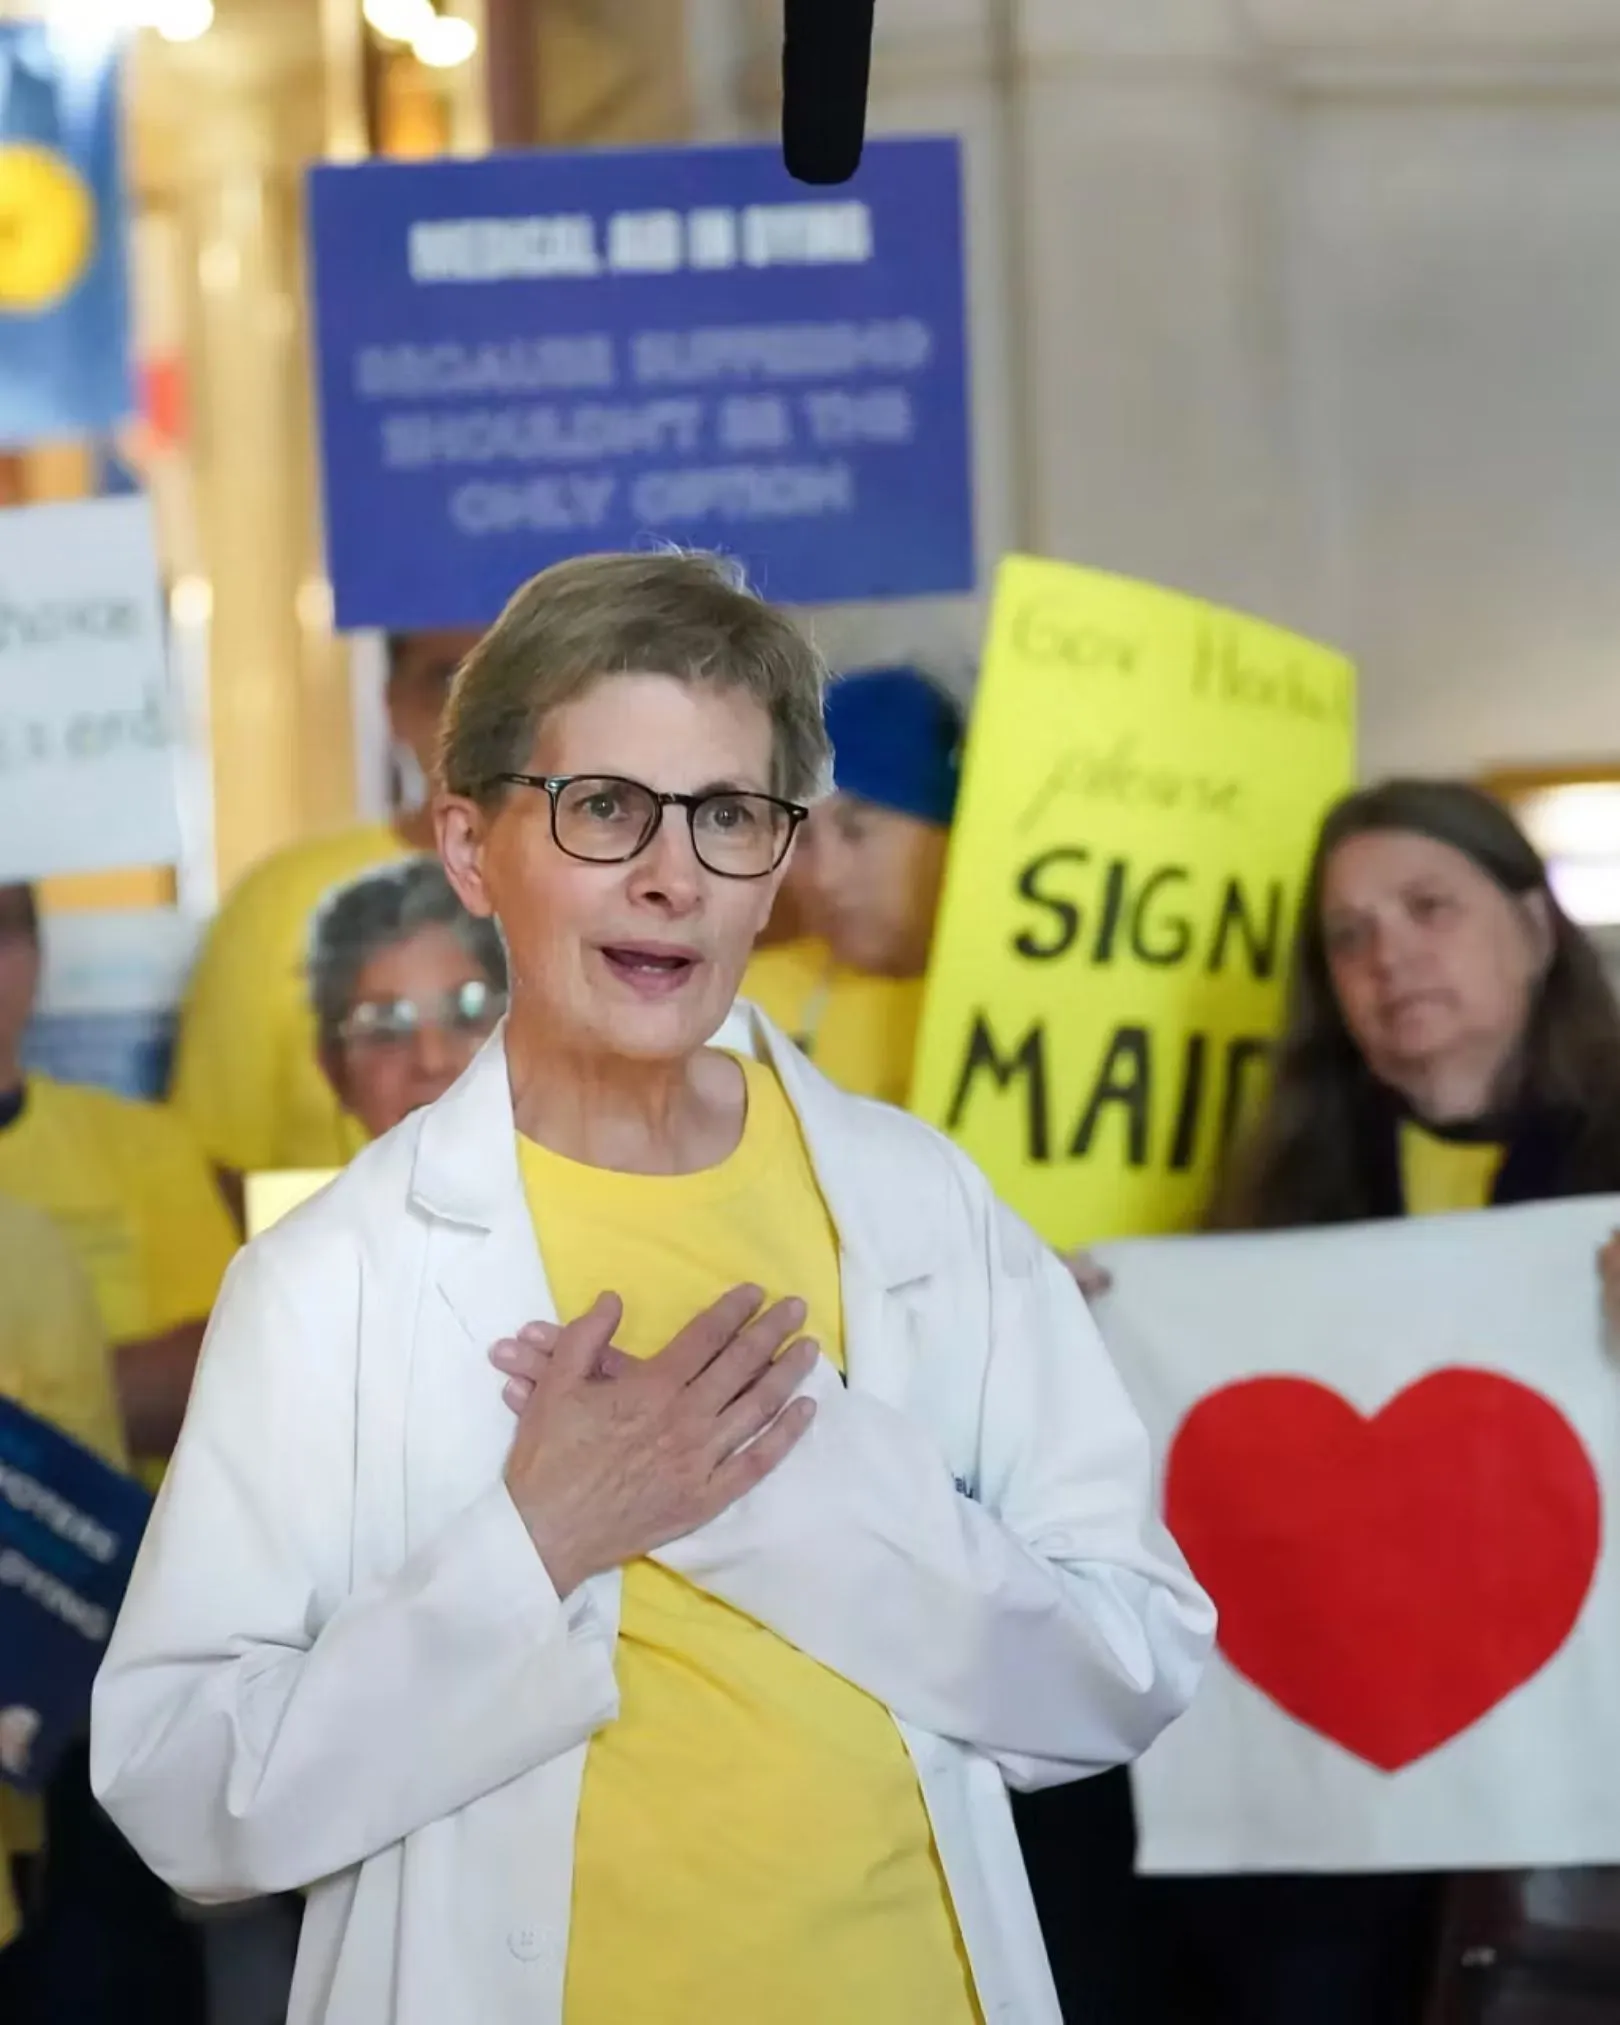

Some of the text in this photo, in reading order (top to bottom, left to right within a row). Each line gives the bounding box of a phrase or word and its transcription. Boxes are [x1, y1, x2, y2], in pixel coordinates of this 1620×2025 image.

[409, 199, 873, 284] MEDICAL AID IN DYING
[355, 334, 615, 397] BECAUSE
[446, 460, 854, 536] ONLY OPTION
[1010, 846, 1284, 981] SIGN
